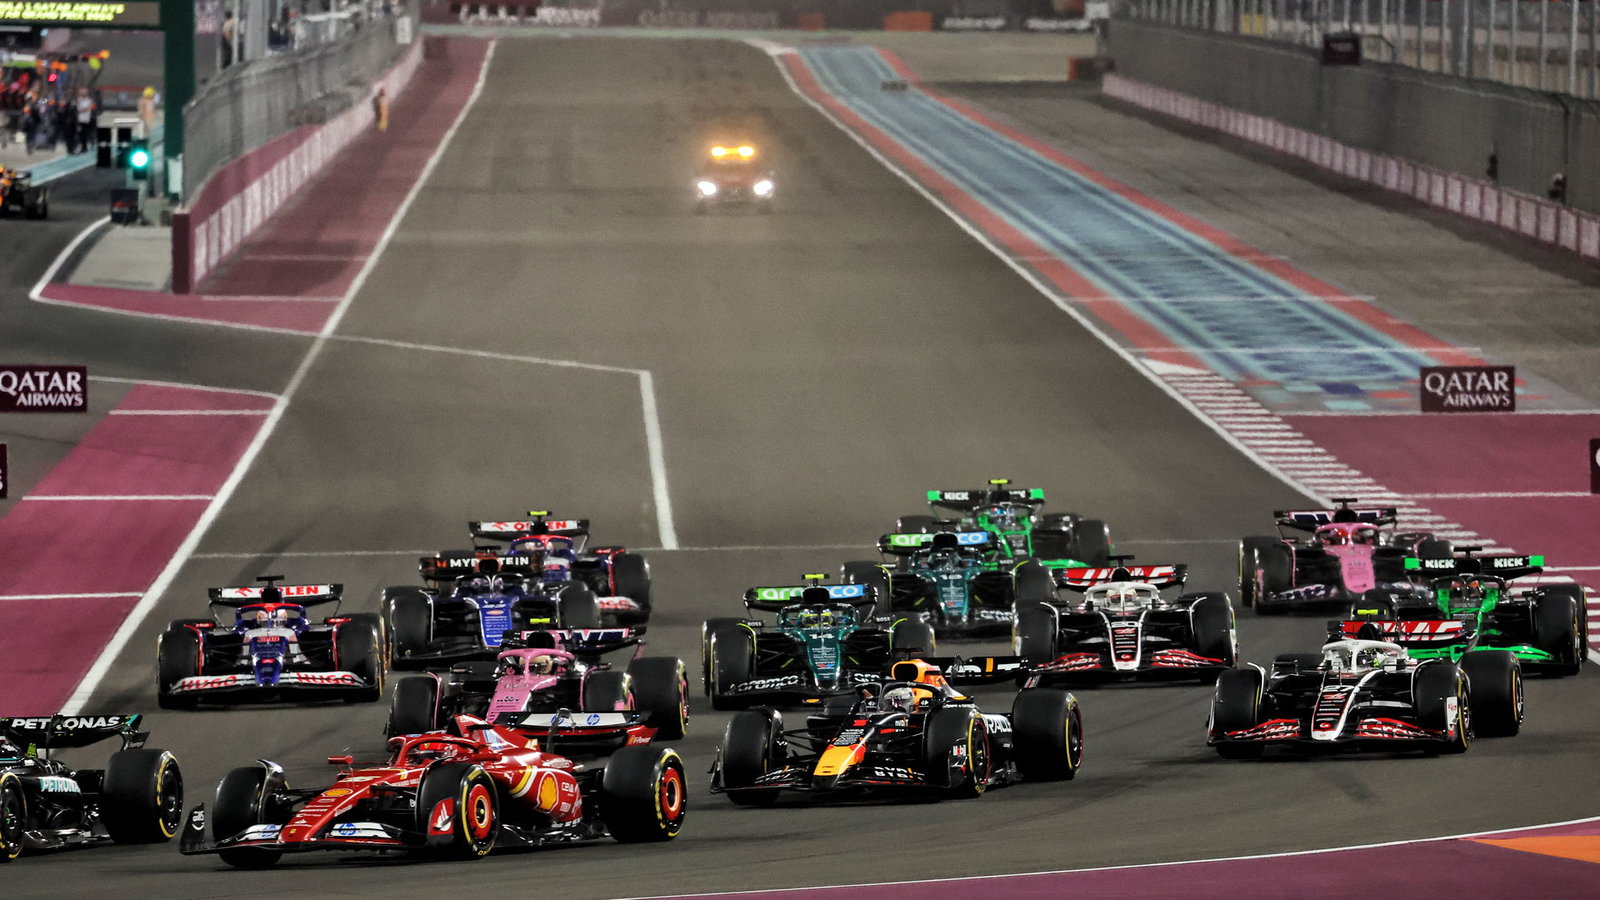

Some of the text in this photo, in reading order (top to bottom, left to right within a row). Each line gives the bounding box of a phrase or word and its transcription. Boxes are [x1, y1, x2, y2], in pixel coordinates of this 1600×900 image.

[34, 2, 71, 12] QATAR
[0, 371, 81, 396] QATAR
[1425, 371, 1509, 396] QATAR
[16, 393, 83, 406] AIRWAYS
[1444, 392, 1511, 406] AIRWAYS
[944, 492, 969, 501] KICK
[1494, 558, 1523, 568] KICK
[181, 675, 237, 691] HUGO
[296, 672, 356, 689] HUGO
[12, 717, 120, 730] PETONAS
